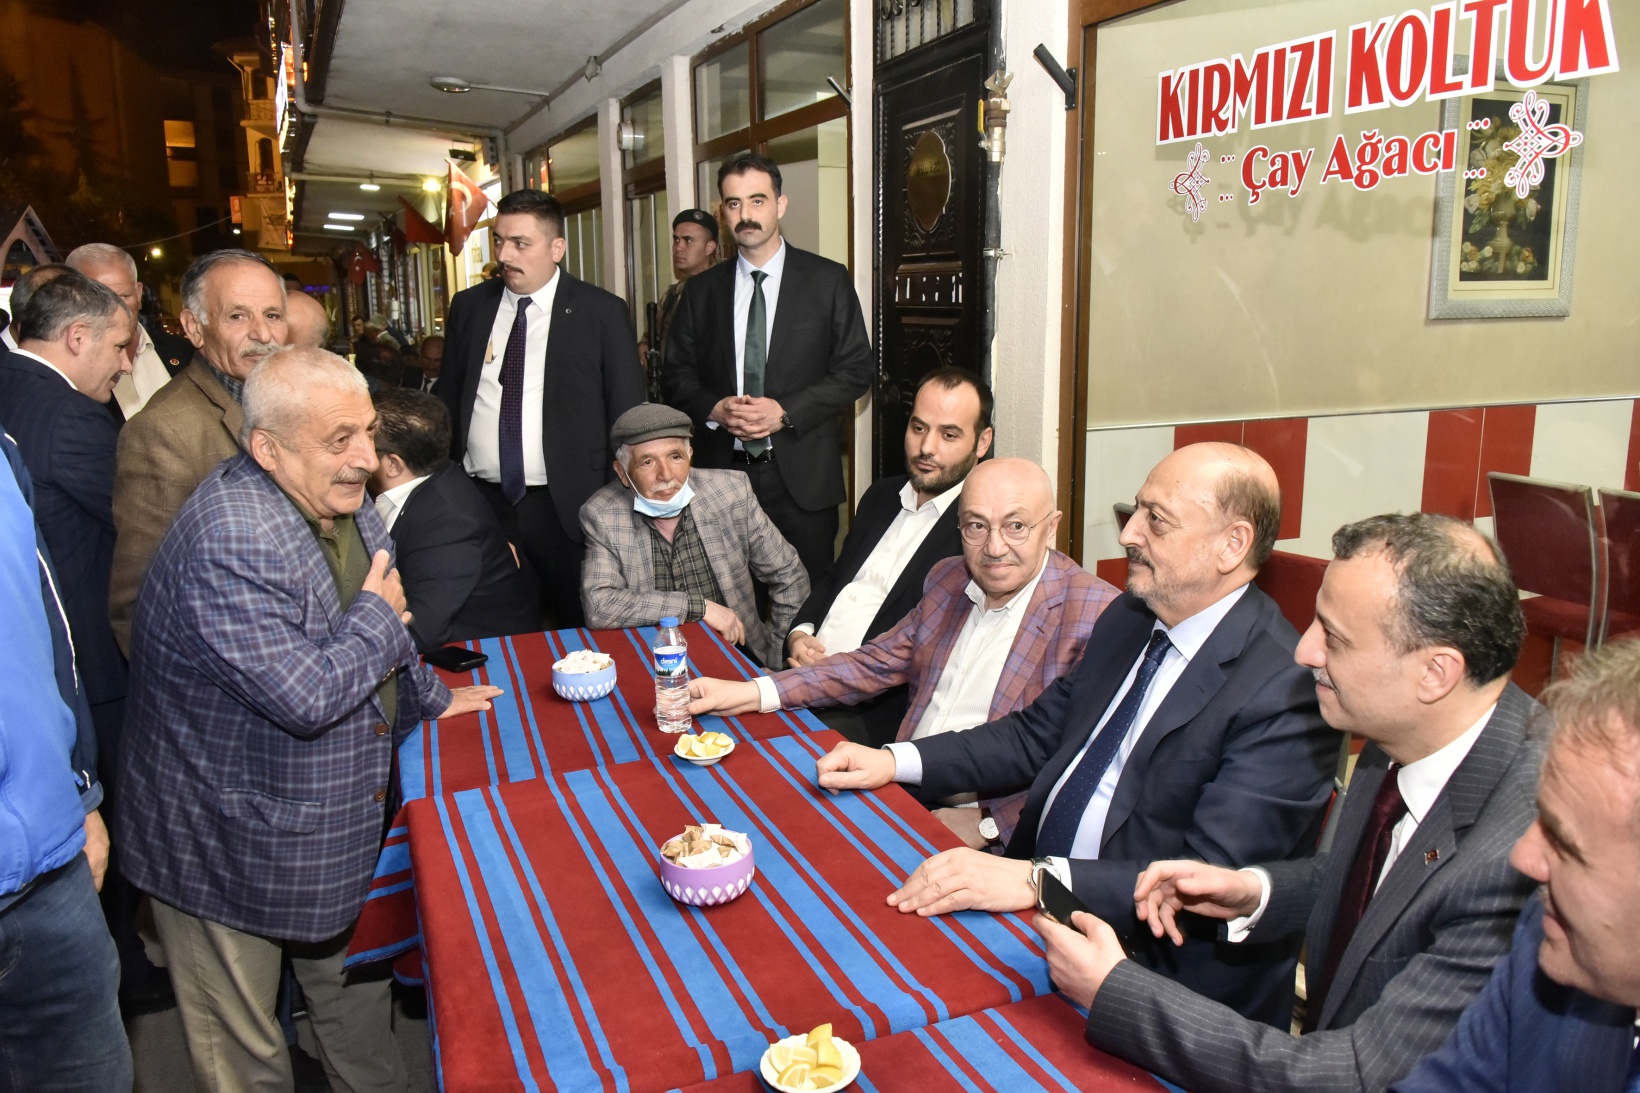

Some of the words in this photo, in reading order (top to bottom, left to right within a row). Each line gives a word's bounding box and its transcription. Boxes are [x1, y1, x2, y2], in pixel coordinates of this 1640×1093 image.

[1157, 31, 1335, 143] KIRMIZI
[1346, 0, 1617, 112] KOLTUK
[1242, 147, 1314, 205] Çay
[1321, 130, 1457, 190] Ağacı
